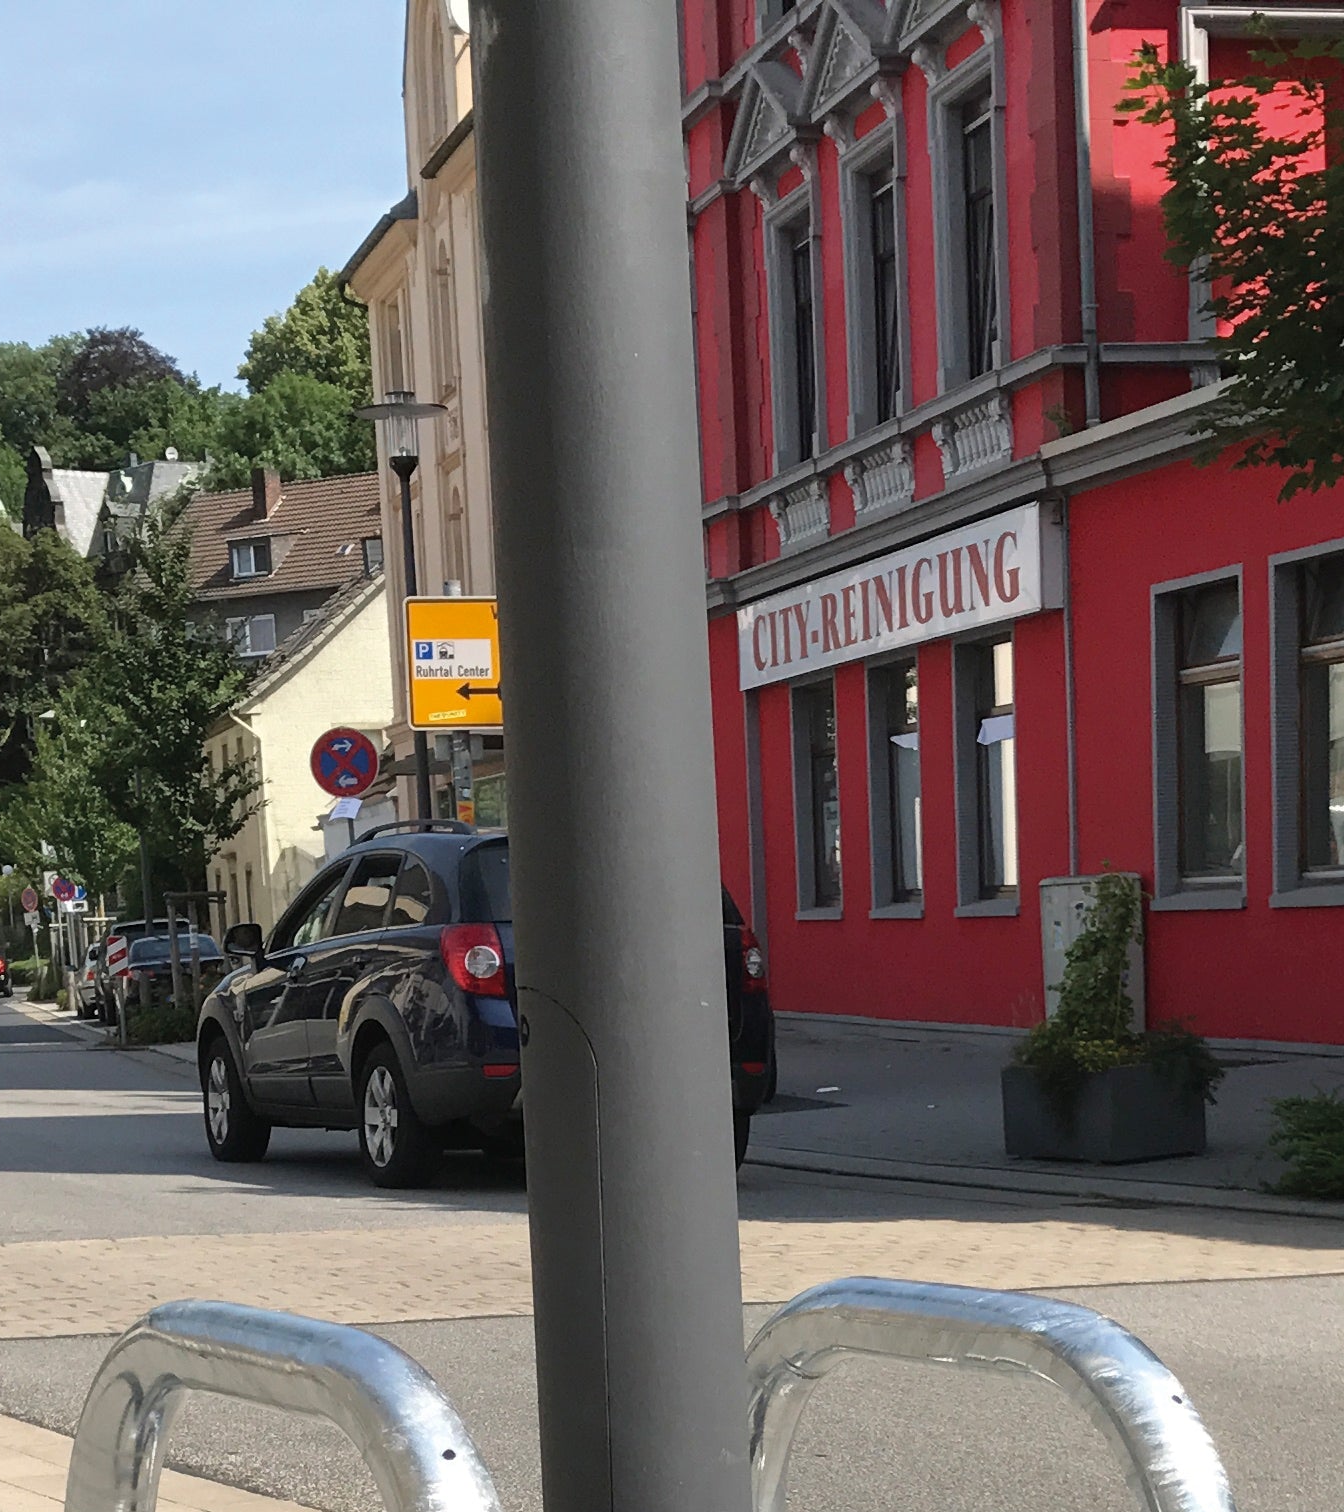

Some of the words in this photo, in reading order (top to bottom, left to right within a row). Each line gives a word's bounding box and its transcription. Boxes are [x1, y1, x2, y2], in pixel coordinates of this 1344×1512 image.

[752, 531, 1021, 671] CITY-REINIGUNG
[416, 665, 453, 678] Ruhrtal
[457, 665, 490, 677] Center
